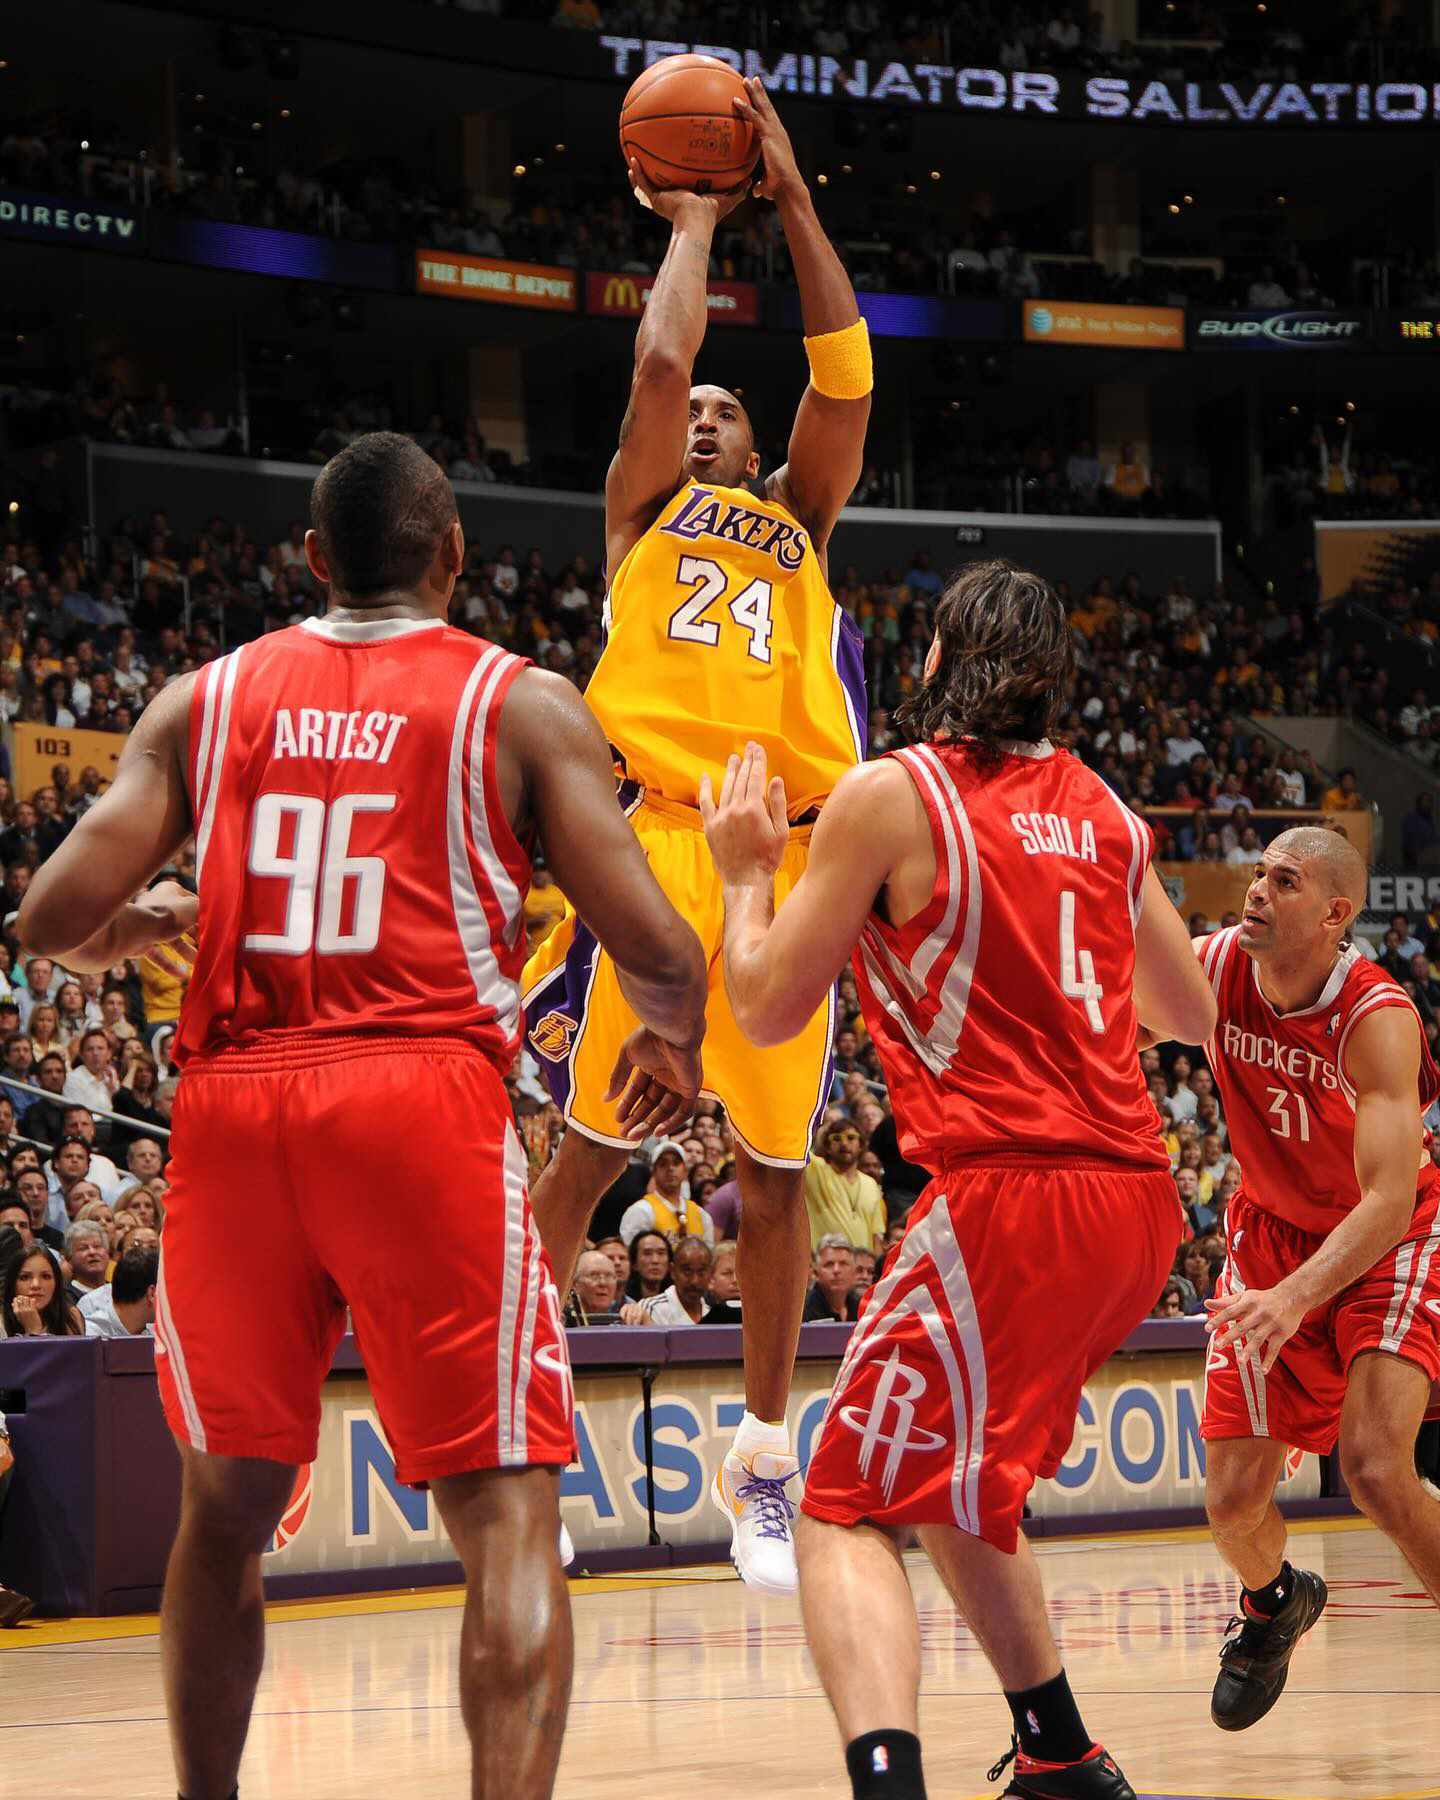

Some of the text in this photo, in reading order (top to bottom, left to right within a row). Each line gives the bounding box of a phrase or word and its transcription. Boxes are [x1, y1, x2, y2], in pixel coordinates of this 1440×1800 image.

[1086, 77, 1440, 122] SALVATIO
[0, 201, 135, 238] DIRECTV
[419, 261, 573, 299] THE HOME DEPOT
[1198, 319, 1360, 337] BUD LIGHT
[1400, 321, 1434, 339] THE
[657, 486, 808, 573] LAKERS
[668, 553, 774, 665] 24
[34, 738, 71, 757] 103
[273, 707, 408, 764] ARTEST
[1010, 811, 1098, 864] SCOLA
[244, 792, 398, 956] 96
[1060, 889, 1105, 1034] 4
[1222, 1018, 1339, 1090] ROCKETS
[1266, 1086, 1310, 1143] 31
